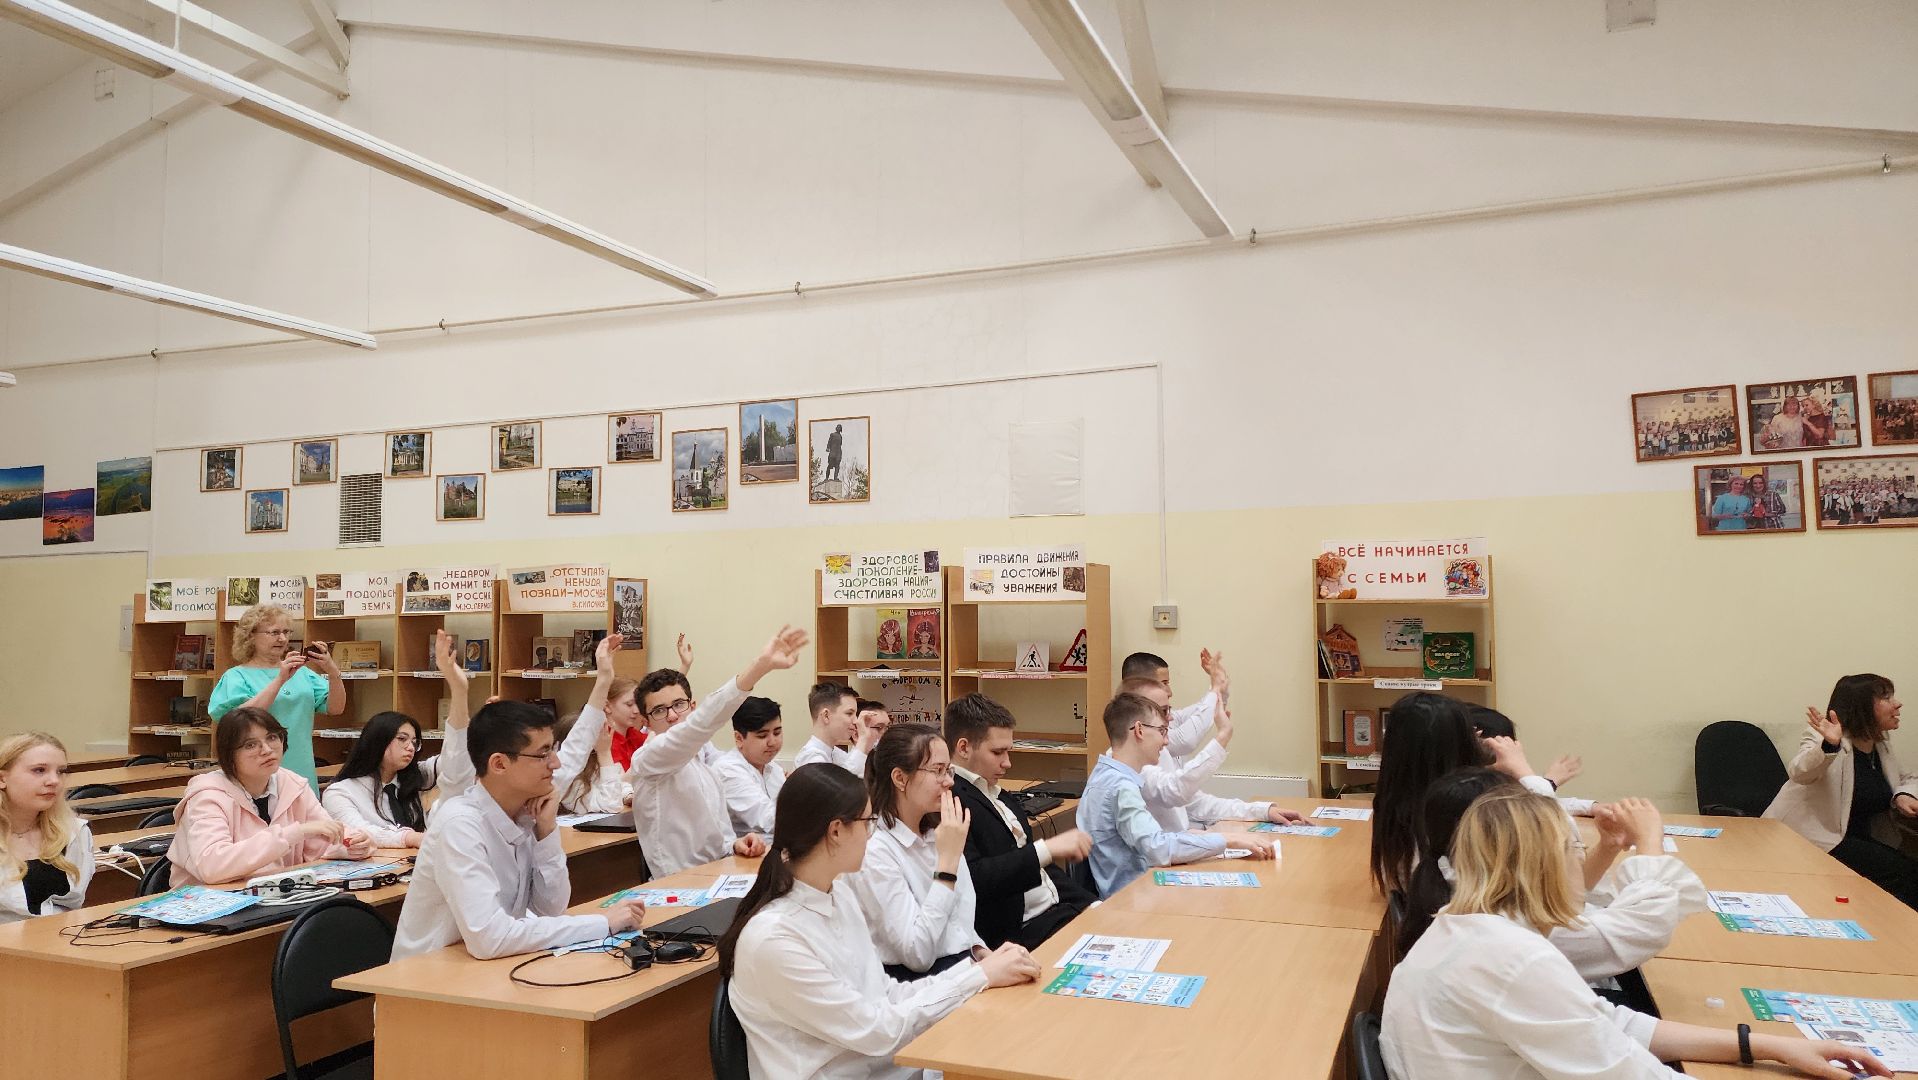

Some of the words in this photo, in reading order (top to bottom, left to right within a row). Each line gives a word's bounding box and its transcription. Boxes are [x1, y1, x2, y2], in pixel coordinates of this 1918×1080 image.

[1338, 544, 1366, 558] ВСЁ
[1374, 543, 1469, 557] НАЧИНАЕТСЯ
[978, 553, 1029, 564] ПРАВИЛА
[1036, 550, 1079, 563] ДВИЖЕНИЯ
[1001, 566, 1060, 579] ДОСТОЙНЫ
[1347, 573, 1357, 584] С
[1365, 572, 1427, 584] СЕМЬИ
[368, 576, 388, 586] МОЯ
[433, 580, 479, 590] ПОМНИТ
[176, 585, 199, 596] МОЁ
[1003, 583, 1058, 594] УВАЖЕНИЯ
[834, 589, 904, 600] СЧАСТЛИВАЯ
